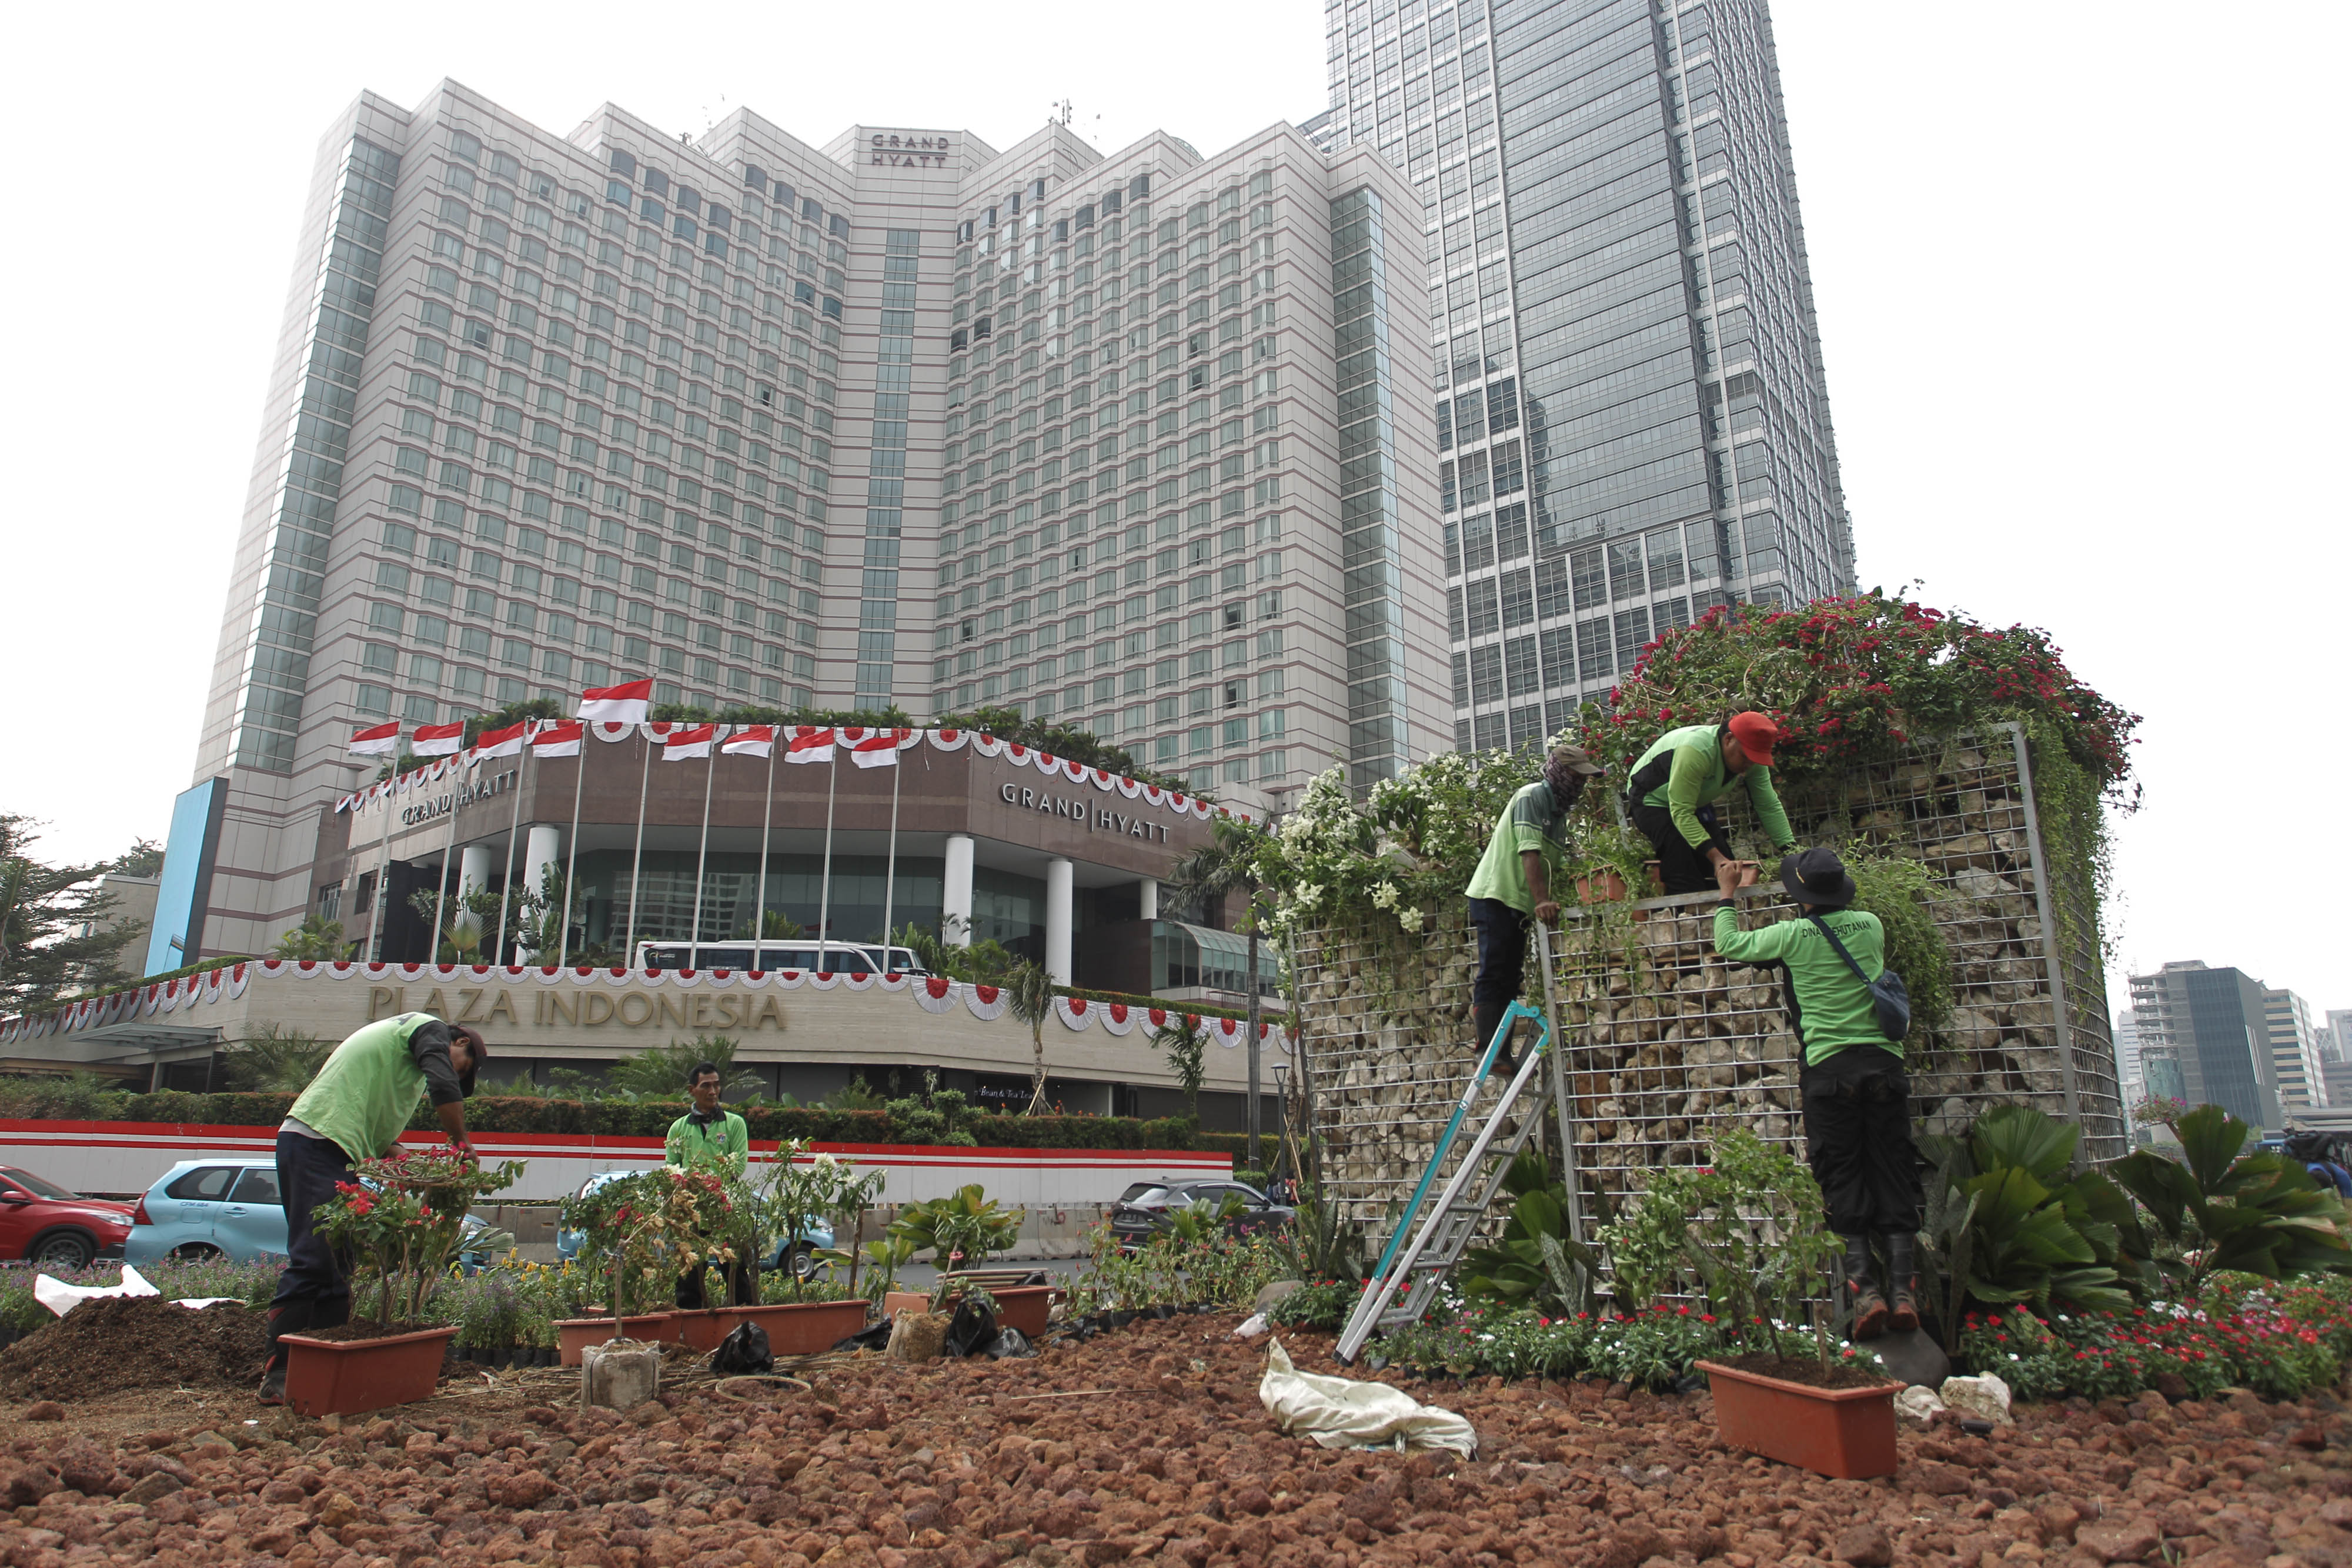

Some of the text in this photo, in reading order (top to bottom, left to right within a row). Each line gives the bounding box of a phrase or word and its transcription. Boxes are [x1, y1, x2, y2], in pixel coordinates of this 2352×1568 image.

[872, 134, 948, 149] GRAND
[872, 153, 946, 168] HYATT
[401, 769, 515, 824] GRAND HYATT
[1001, 783, 1170, 843] GRAND HYATT
[1802, 920, 1872, 938] DINA EHUTANAN
[366, 986, 787, 1029] PLAZA INDONESIA
[980, 1088, 998, 1098] Bean
[999, 1089, 1005, 1098] &
[1006, 1089, 1018, 1099] Tea
